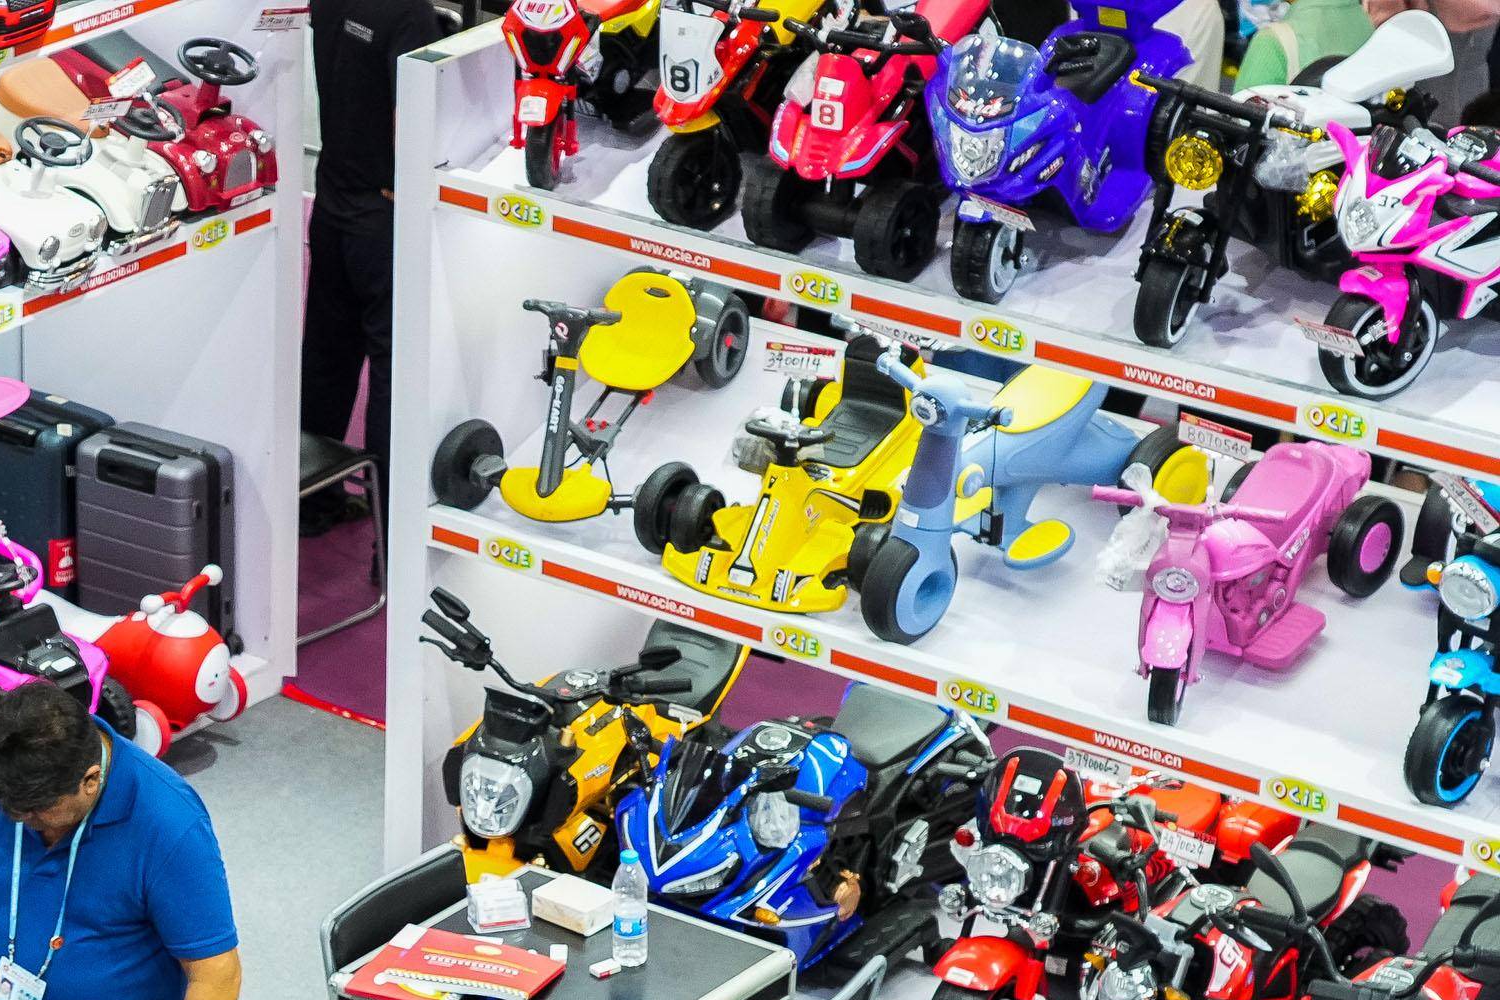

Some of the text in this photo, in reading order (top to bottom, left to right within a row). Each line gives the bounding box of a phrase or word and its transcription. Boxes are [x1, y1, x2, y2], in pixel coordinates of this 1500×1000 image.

[670, 65, 691, 92] 8
[819, 104, 836, 125] 8
[1379, 195, 1401, 209] 37
[630, 237, 711, 271] www.ocie.cn
[1124, 363, 1216, 401] www.ocie.cn
[550, 374, 566, 434] GO-KART
[616, 584, 696, 619] www.ocie.cn
[1093, 732, 1182, 768] www.ocie.cn
